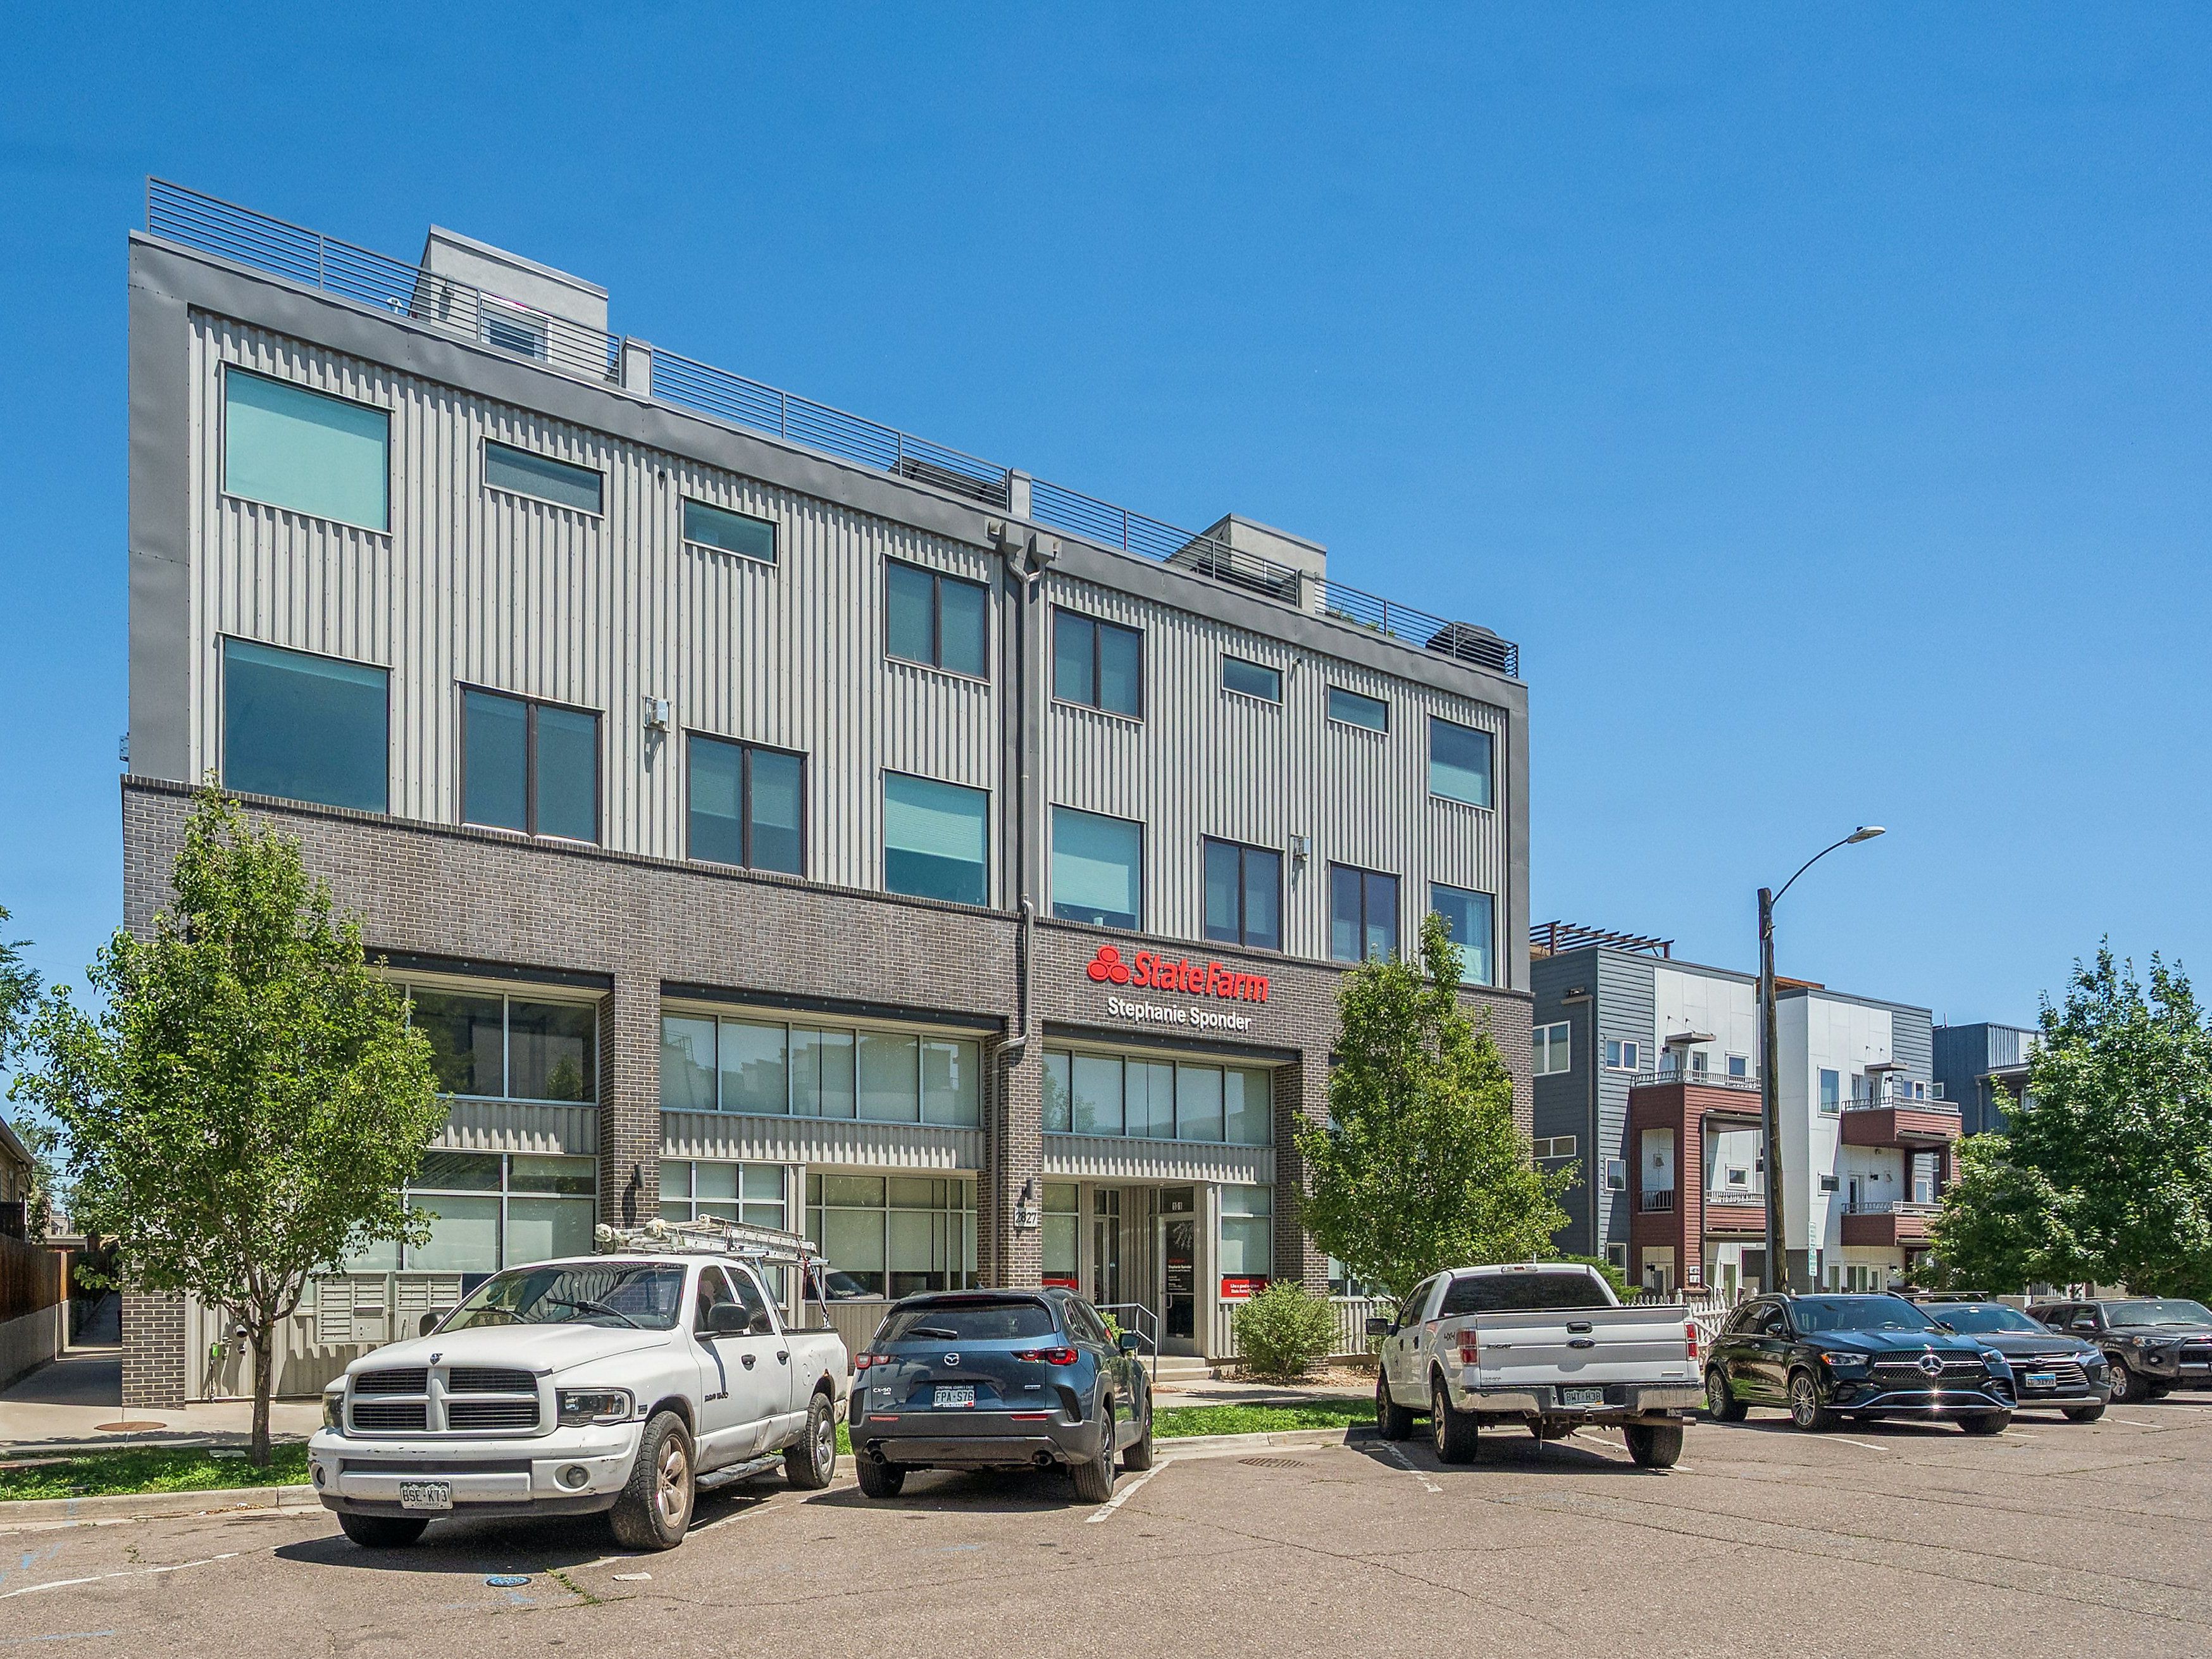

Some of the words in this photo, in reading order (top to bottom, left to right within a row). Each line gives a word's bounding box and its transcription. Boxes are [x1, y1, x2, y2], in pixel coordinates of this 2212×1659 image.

[1108, 997, 1186, 1024] Stephanie
[1190, 1007, 1252, 1031] Sponder
[1015, 1212, 1037, 1224] 2827
